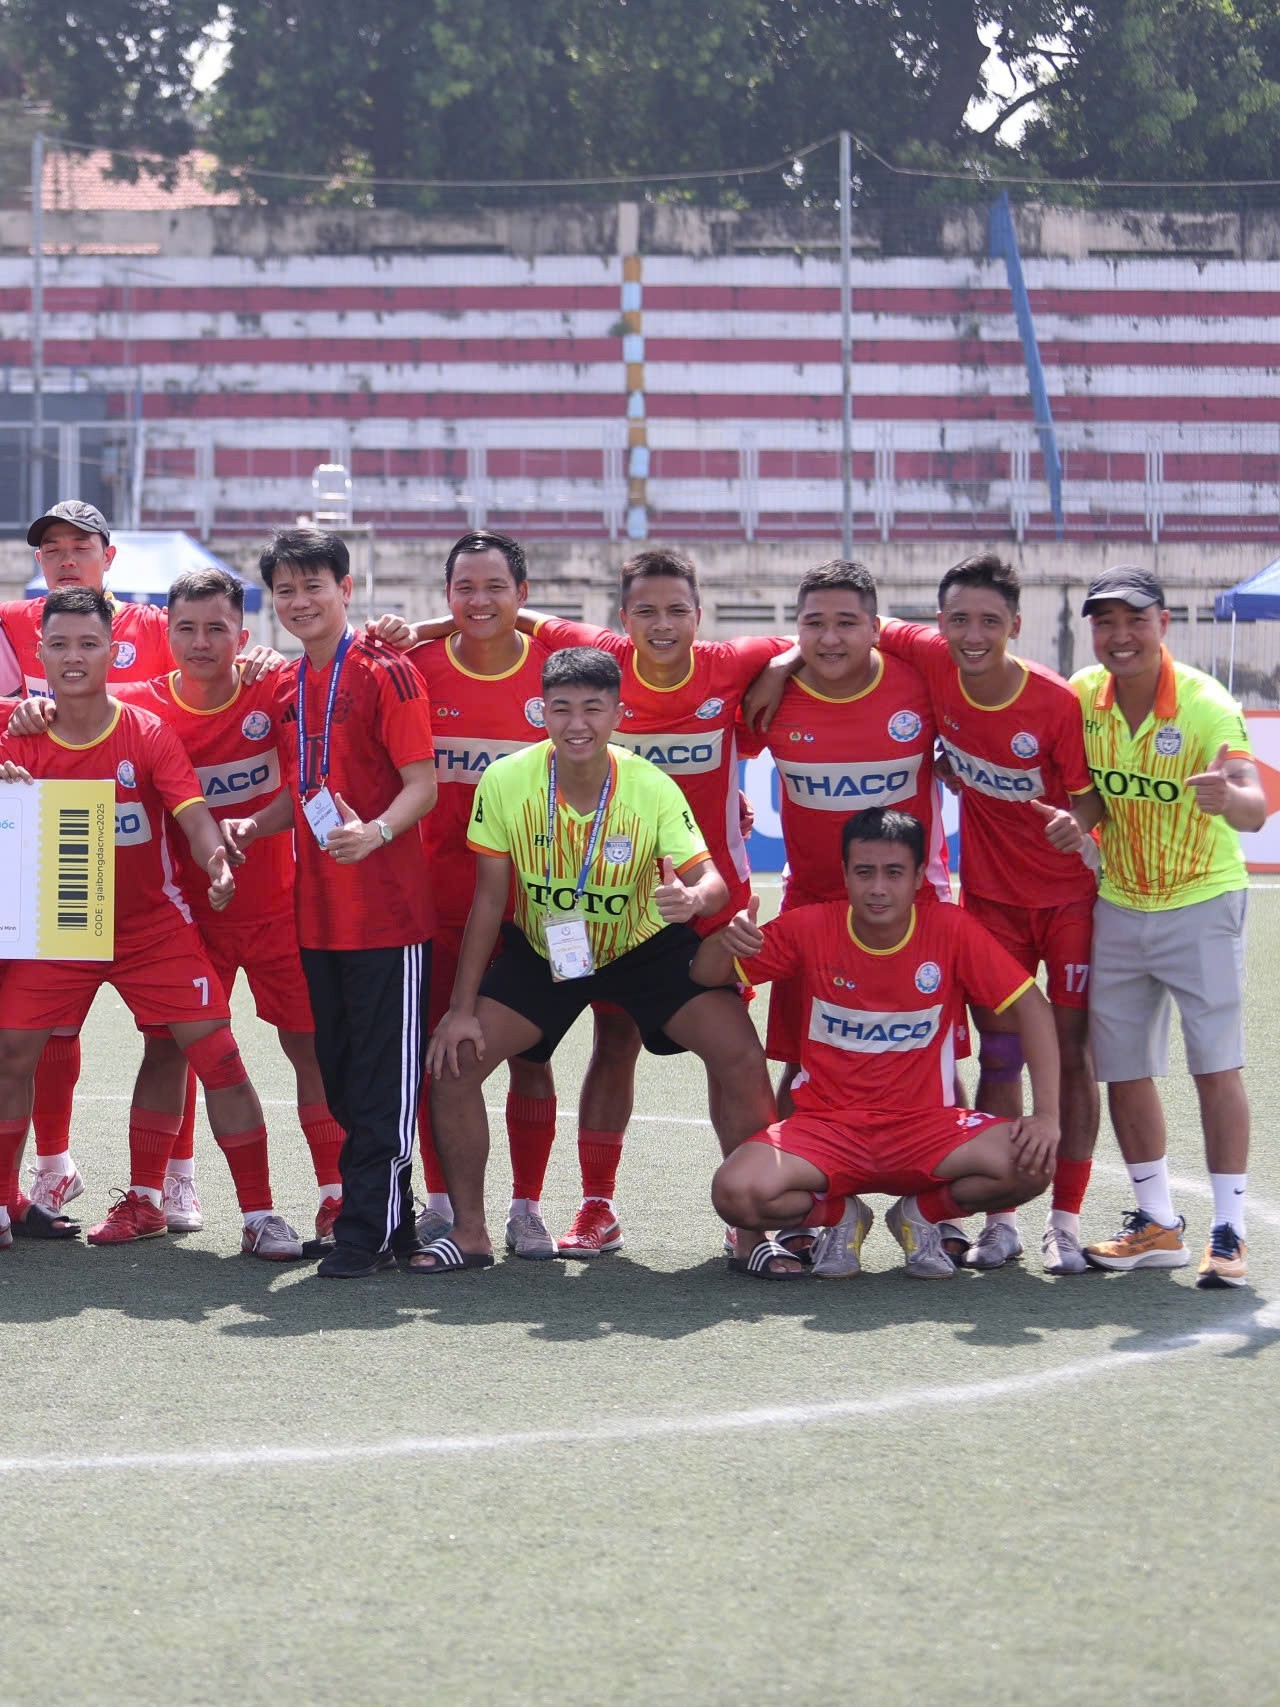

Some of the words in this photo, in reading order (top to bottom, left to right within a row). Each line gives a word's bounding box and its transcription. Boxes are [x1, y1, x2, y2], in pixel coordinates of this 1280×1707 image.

[1085, 720, 1103, 736] HY
[434, 749, 511, 772] THA
[608, 741, 712, 764] ACO
[205, 764, 269, 796] ACO
[785, 770, 909, 797] THACO
[1089, 768, 1179, 802] TOTO
[95, 803, 105, 901] giaibongdacnvc2025
[534, 834, 553, 849] HY
[527, 882, 629, 915] TOTO
[192, 976, 209, 1006] 7
[1064, 963, 1089, 993] 17
[821, 1013, 932, 1042] THACO
